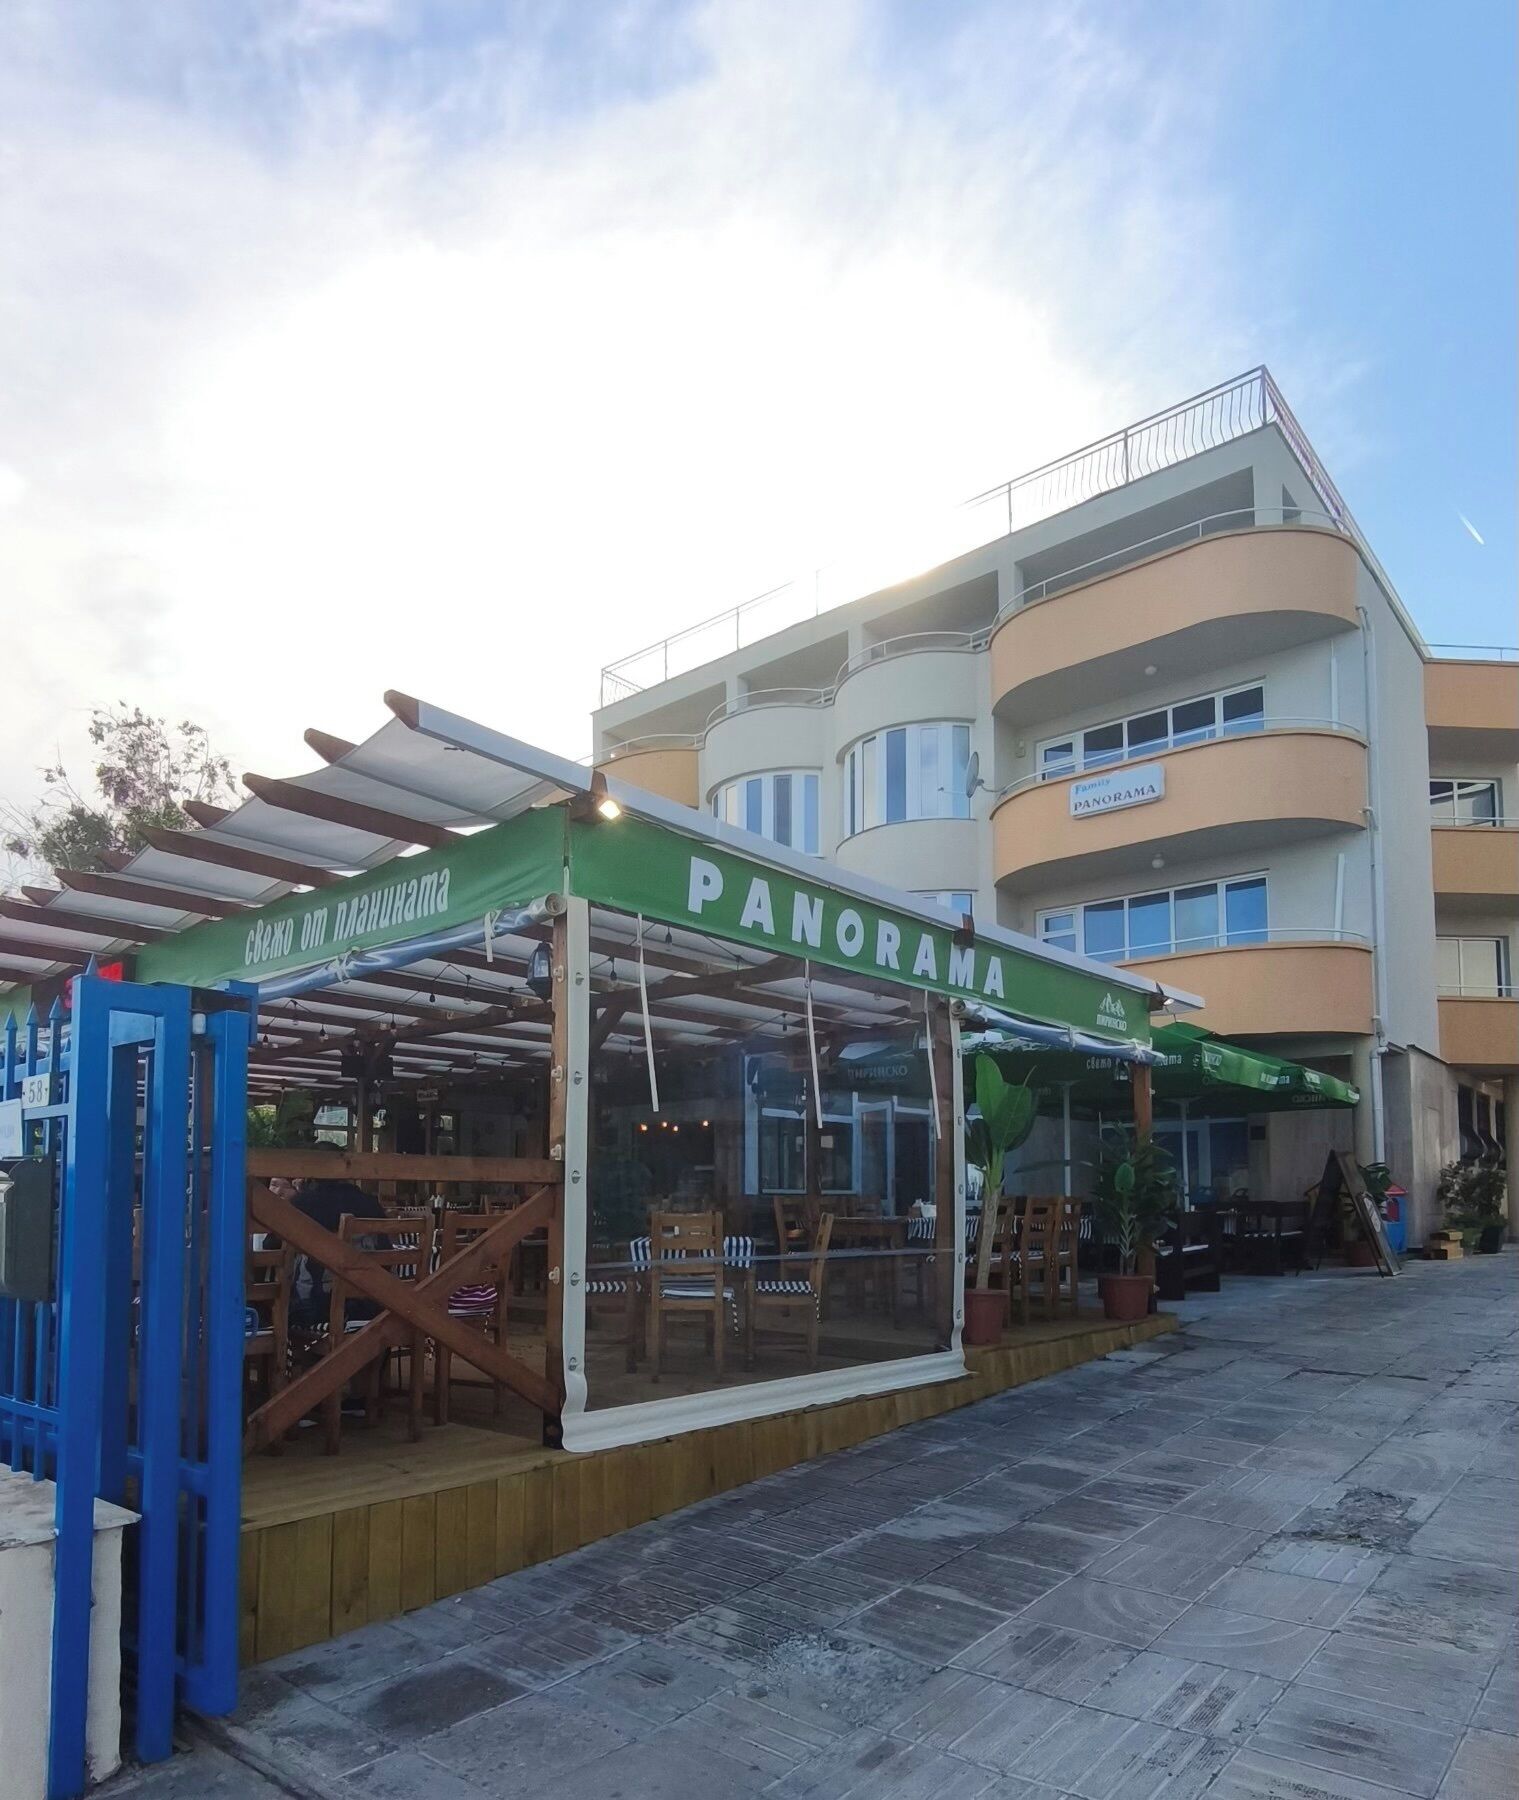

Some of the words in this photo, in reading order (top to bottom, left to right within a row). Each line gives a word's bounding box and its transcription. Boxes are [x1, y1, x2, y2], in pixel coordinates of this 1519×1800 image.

[1074, 784, 1156, 811] PANORAMA
[1075, 778, 1111, 795] Family
[244, 917, 294, 966] свежо
[300, 906, 328, 951] от
[333, 867, 451, 942] планината
[688, 856, 1005, 999] PANORAMA
[28, 1079, 43, 1104] 58
